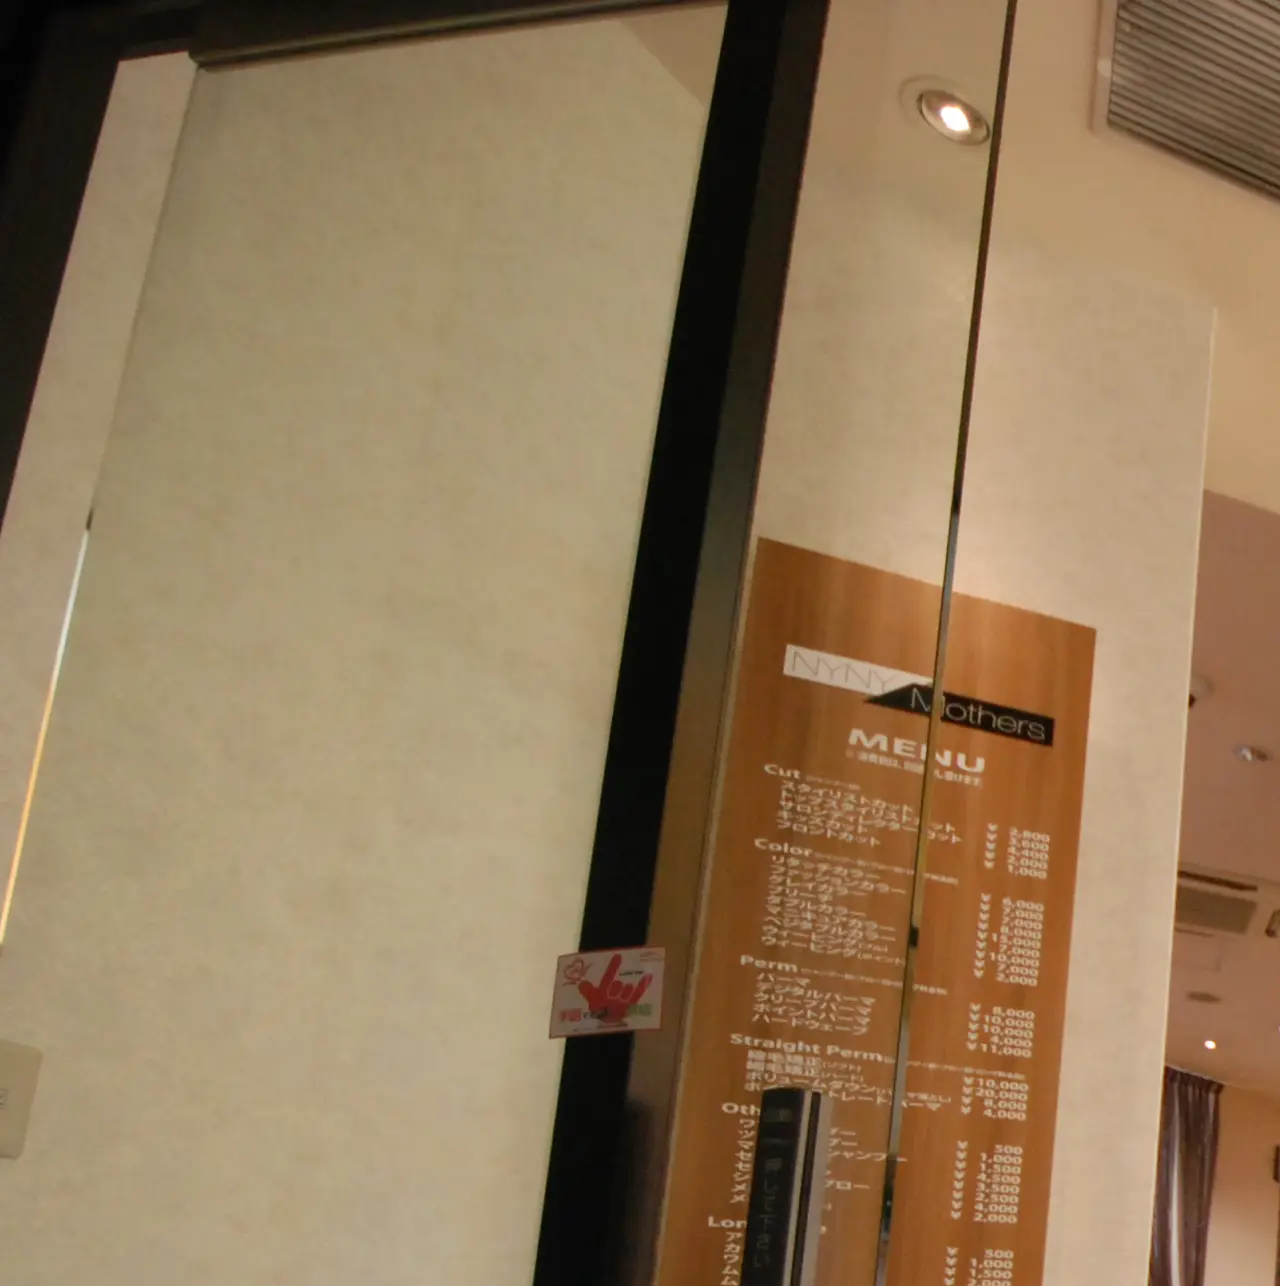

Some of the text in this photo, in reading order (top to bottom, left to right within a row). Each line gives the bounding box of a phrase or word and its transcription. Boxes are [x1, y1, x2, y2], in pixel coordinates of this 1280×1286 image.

[792, 650, 896, 692] NYNY
[910, 687, 1046, 741] Mothers
[848, 727, 985, 774] MENU
[763, 763, 800, 779] Cut
[754, 838, 813, 857] Color
[740, 955, 798, 972] Perm
[730, 1033, 884, 1063] Straight Perm
